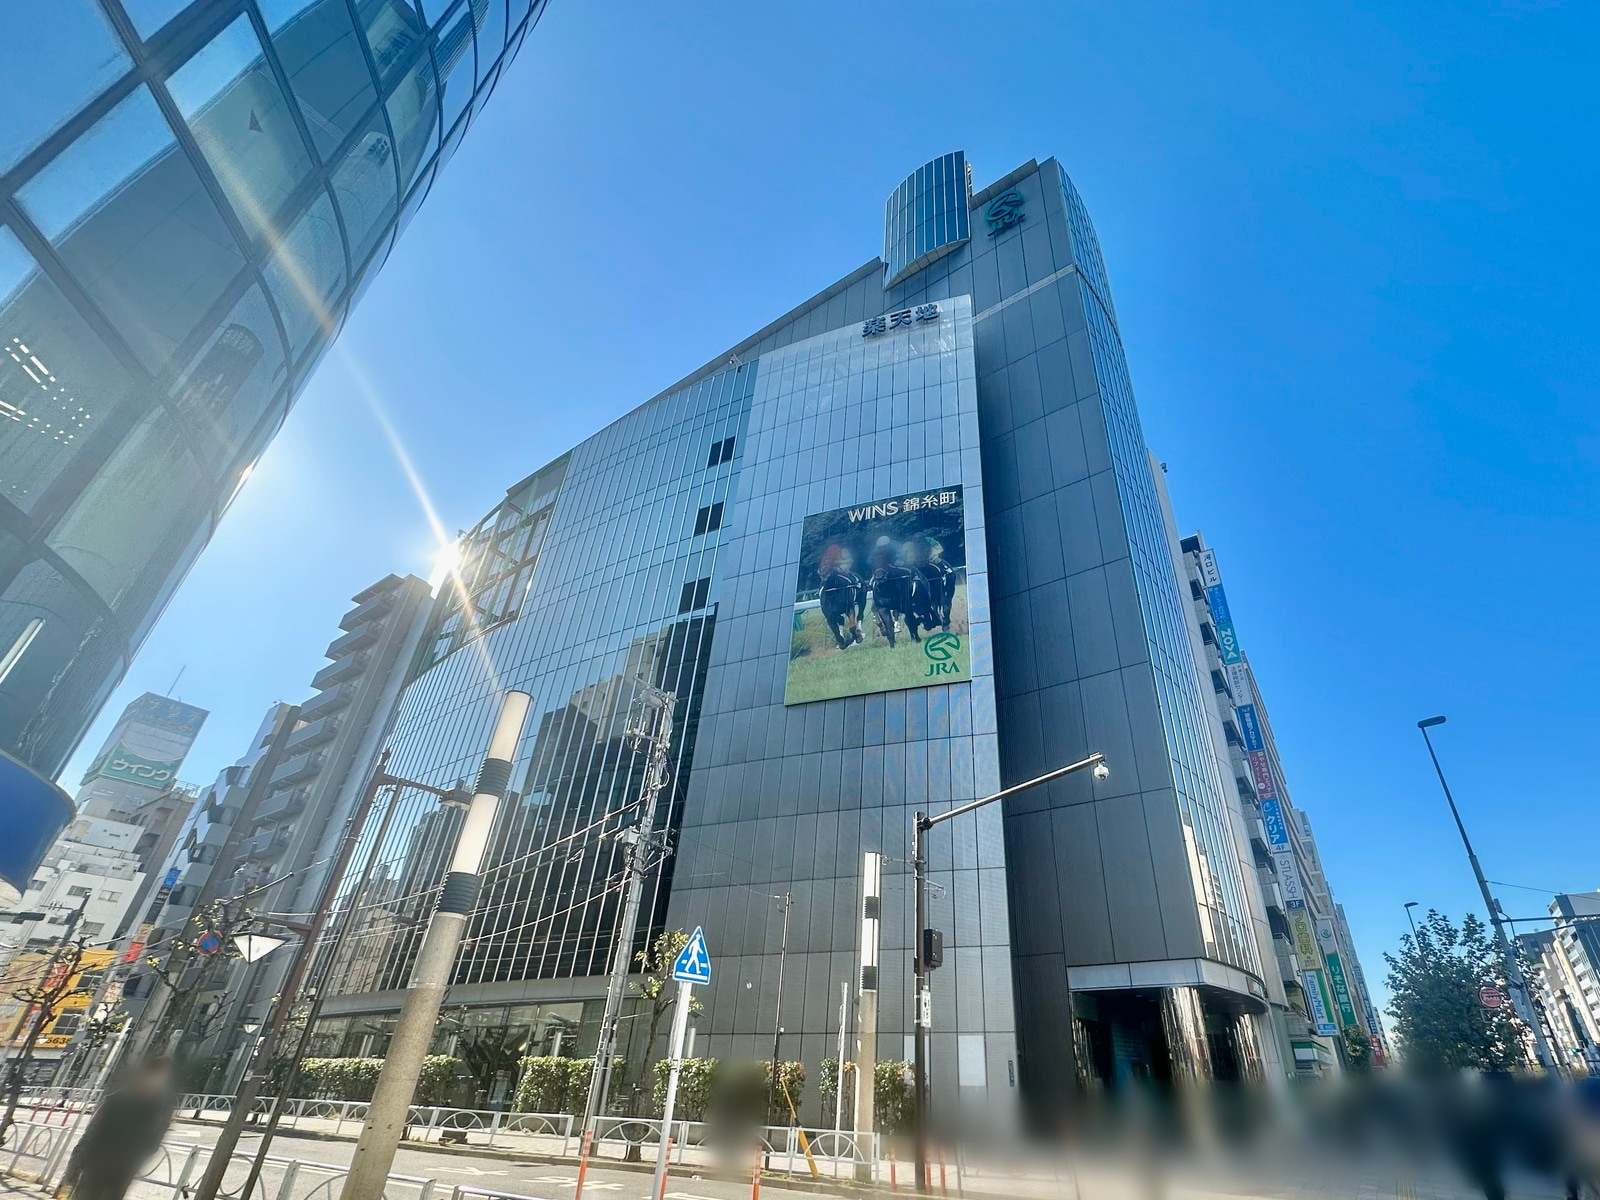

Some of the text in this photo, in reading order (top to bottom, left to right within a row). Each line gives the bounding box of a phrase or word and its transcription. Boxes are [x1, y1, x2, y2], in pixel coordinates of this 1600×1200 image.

[861, 303, 940, 338] 楽天地
[848, 491, 957, 523] WINS 錦糸町
[1220, 628, 1238, 660] NOVA
[925, 661, 960, 677] JRA
[111, 758, 171, 781] ウイング
[1266, 815, 1280, 843] クリア
[1275, 844, 1286, 852] 4F
[1280, 859, 1297, 899] STLASSH
[1290, 900, 1301, 909] 3F
[1307, 975, 1324, 1019] FamilyMart
